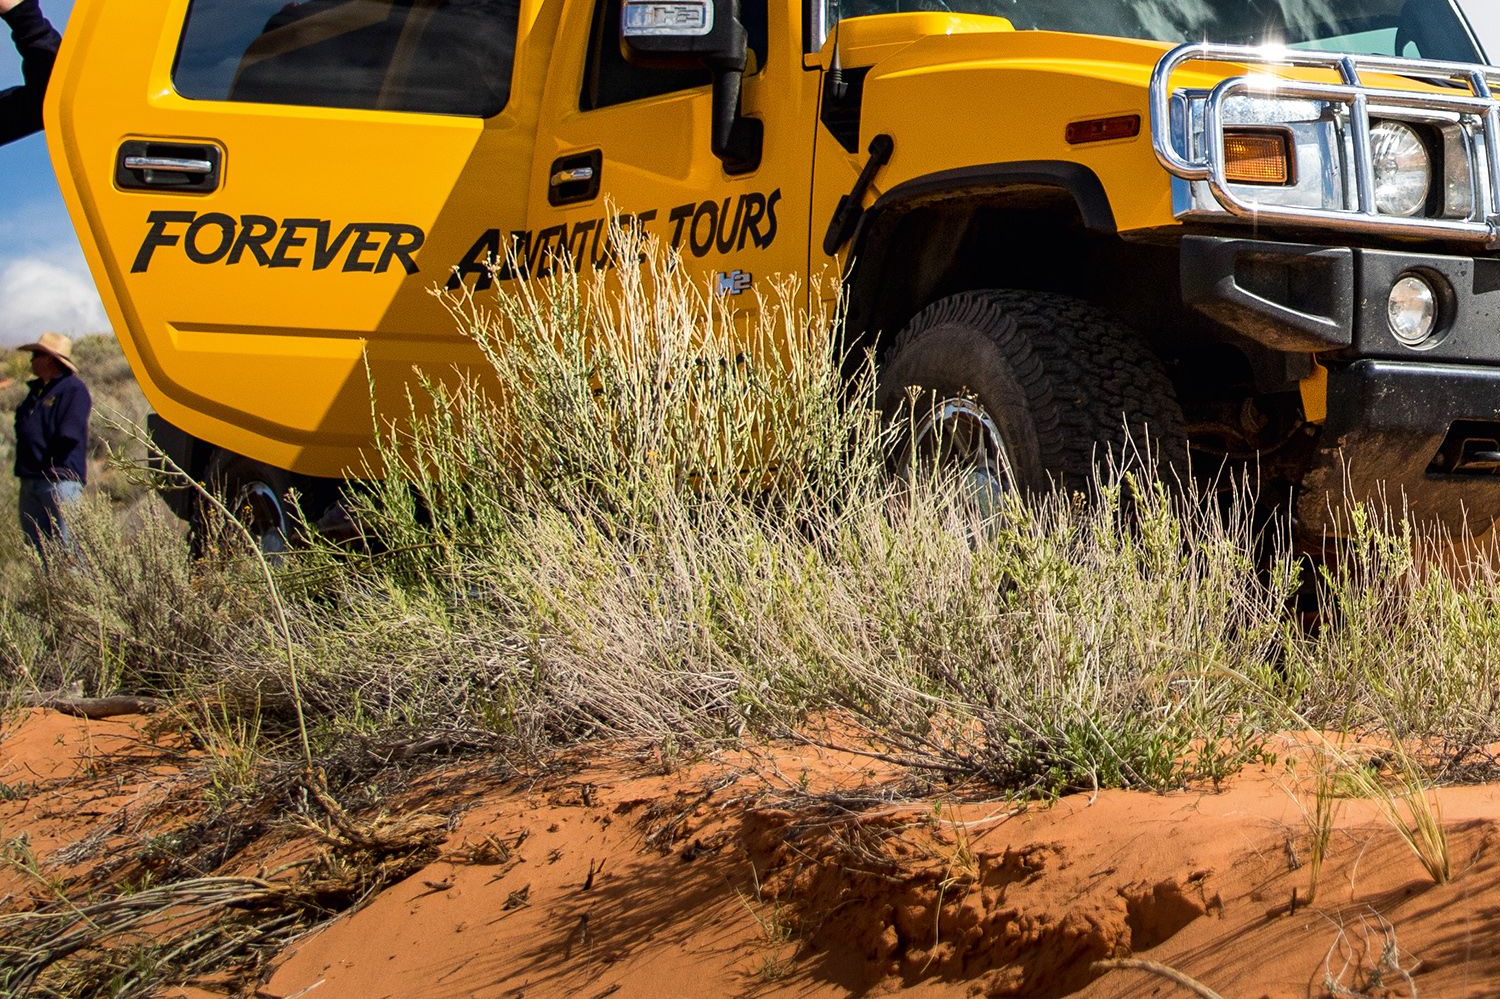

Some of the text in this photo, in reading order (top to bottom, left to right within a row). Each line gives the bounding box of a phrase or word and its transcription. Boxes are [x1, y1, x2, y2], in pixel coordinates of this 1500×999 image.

[130, 211, 425, 275] FOREVER
[668, 188, 781, 268] TOURS
[715, 269, 752, 296] H2
